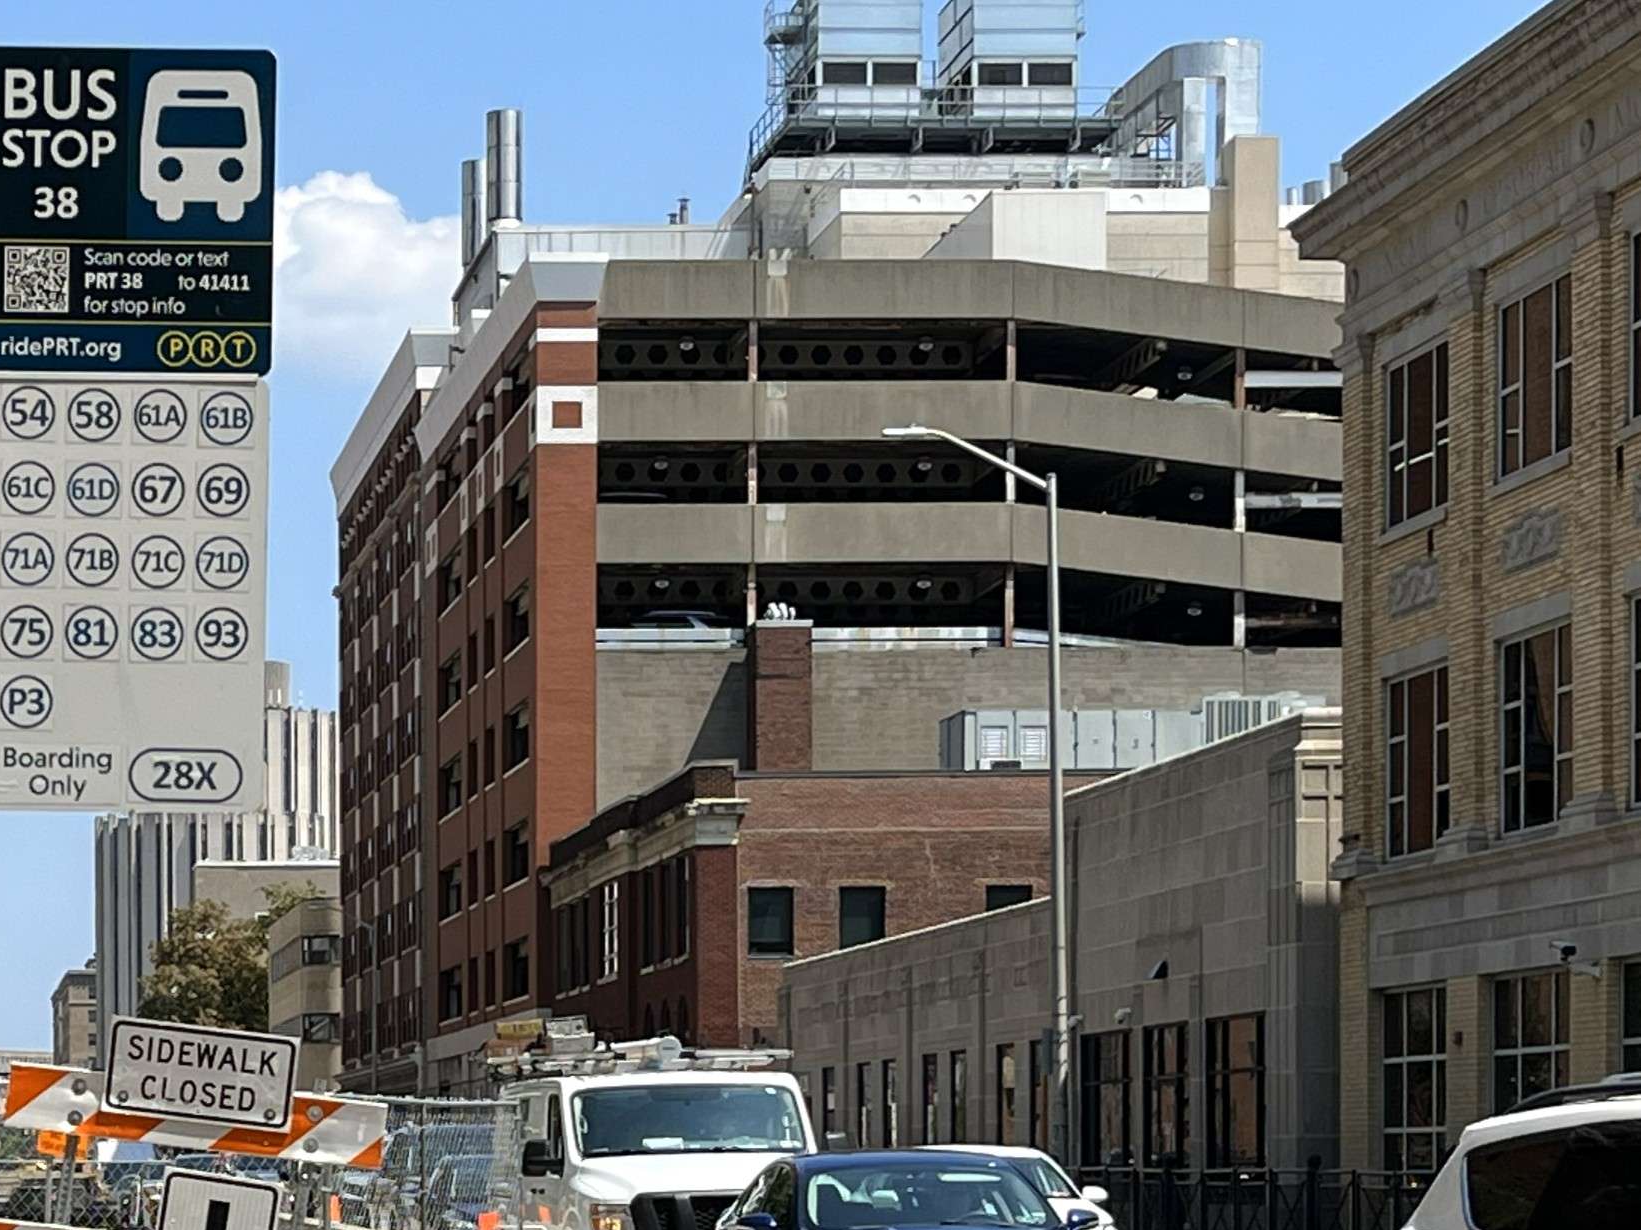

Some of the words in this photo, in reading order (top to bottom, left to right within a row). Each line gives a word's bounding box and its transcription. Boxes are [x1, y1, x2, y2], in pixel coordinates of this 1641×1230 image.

[4, 68, 117, 121] BUS
[2, 128, 117, 168] STOP
[34, 186, 79, 219] 38
[84, 247, 124, 266] Scan
[126, 248, 171, 267] code
[174, 252, 193, 267] or
[196, 251, 230, 267] text
[84, 272, 119, 290] PRT
[121, 272, 143, 289] 38
[177, 274, 196, 291] to
[198, 274, 250, 291] 41411
[83, 295, 109, 314] for
[111, 298, 149, 318] stop
[152, 296, 186, 315] info
[0, 336, 122, 362] ridePRT.org
[10, 399, 50, 428] 54
[72, 401, 115, 430] 58
[138, 403, 182, 428] 61A
[205, 405, 247, 429] 61B
[8, 476, 49, 498] 61C
[71, 477, 116, 502] 61D
[140, 475, 180, 505] 67
[205, 476, 244, 507] 69
[7, 547, 49, 571] 71A
[71, 545, 115, 573] 71B
[139, 548, 180, 575] 71C
[201, 549, 245, 577] 71D
[9, 616, 48, 645] 75
[73, 619, 112, 648] 81
[137, 620, 179, 650] 83
[201, 617, 244, 650] 93
[8, 688, 45, 716] P3
[3, 746, 113, 775] Boarding
[152, 760, 218, 791] 28X
[28, 774, 87, 802] Only
[127, 1034, 277, 1077] SIDEWALK
[140, 1075, 257, 1113] CLOSED
